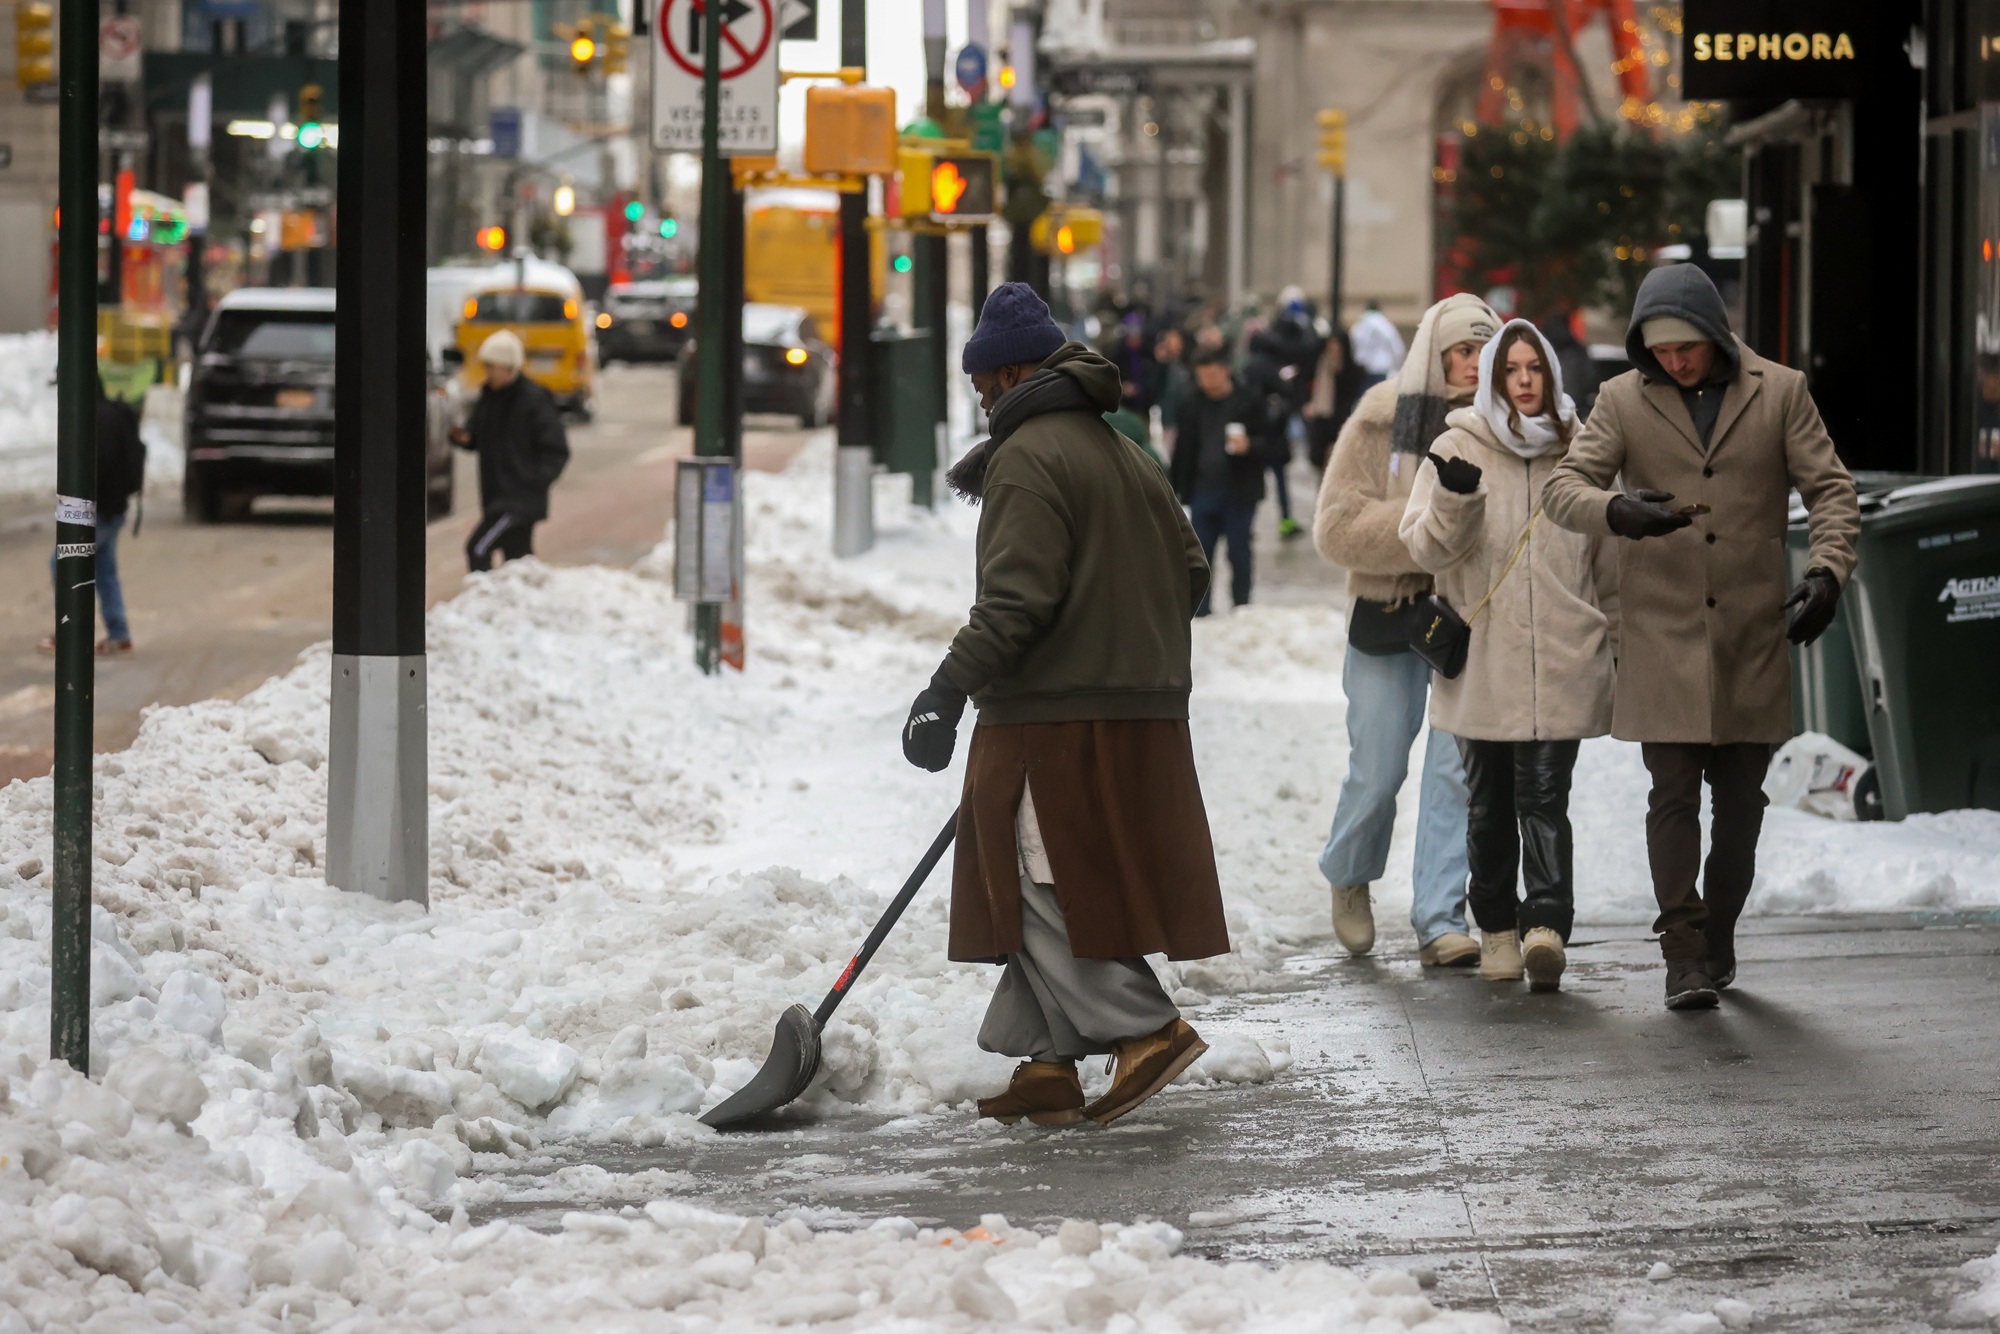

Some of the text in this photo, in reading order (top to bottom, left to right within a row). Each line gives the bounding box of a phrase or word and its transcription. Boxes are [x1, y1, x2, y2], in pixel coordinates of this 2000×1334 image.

[1693, 32, 1855, 61] SEPHORA
[696, 85, 733, 101] FR
[669, 104, 760, 121] VEHLES
[660, 125, 707, 142] OVE
[1937, 576, 2000, 602] ACTIO
